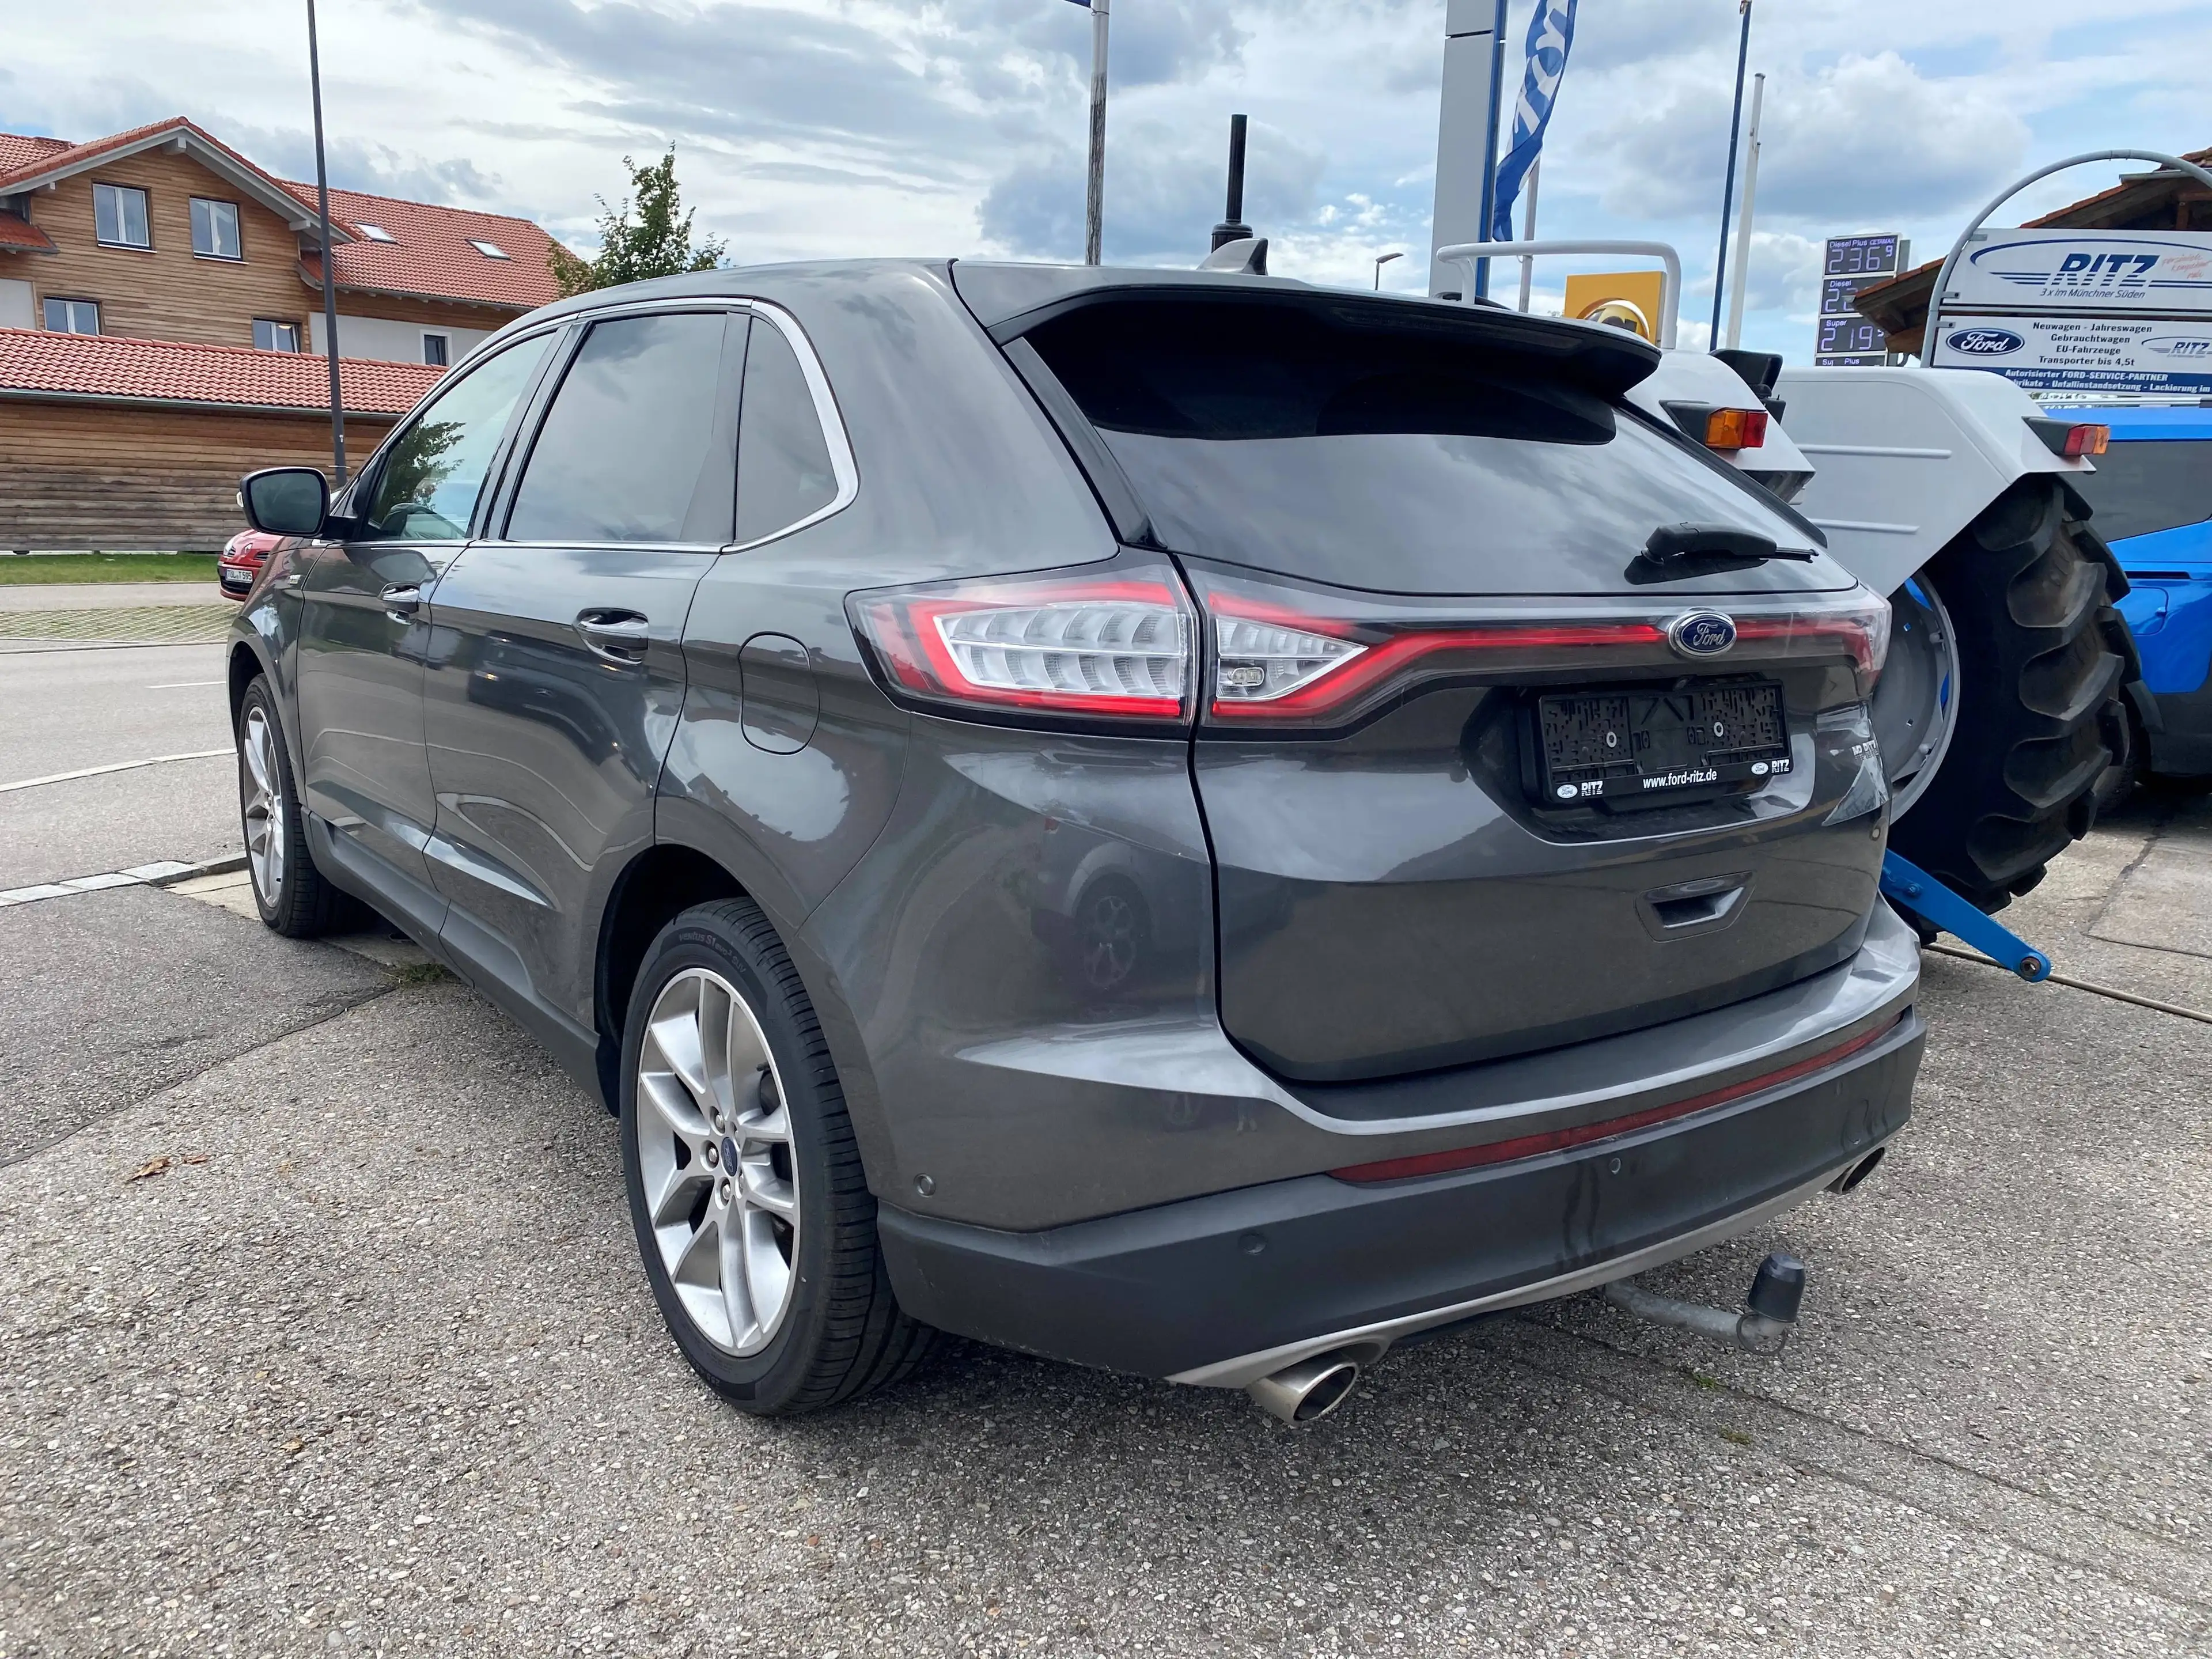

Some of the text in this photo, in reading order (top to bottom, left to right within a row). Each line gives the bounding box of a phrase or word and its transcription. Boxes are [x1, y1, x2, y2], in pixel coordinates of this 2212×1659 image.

[2051, 253, 2160, 287] RITZ
[2040, 289, 2046, 297] 3
[2055, 289, 2067, 297] im
[2068, 289, 2115, 298] Münchner
[2115, 290, 2146, 298] Süden
[1826, 320, 1847, 328] Super
[2033, 322, 2081, 331] Neuwagen
[2090, 324, 2152, 334] Jahreswagen
[1961, 332, 2010, 351] Ford
[2051, 334, 2130, 344] Gebrauchtwagen
[2056, 345, 2121, 355] EU-Fahrzeuge
[2171, 342, 2210, 354] RITZ
[2039, 356, 2095, 366] Transporter
[2115, 358, 2135, 366] 4,5t
[2005, 369, 2168, 381] Autorisierter FORD-SERVICE-PARTNER
[2052, 380, 2142, 391] Unfallinstandsetzung
[2149, 383, 2198, 393] Lackierung
[242, 571, 252, 580] 595
[1693, 623, 1726, 646] Ford
[1581, 781, 1603, 797] RITZ
[1643, 768, 1717, 789] www.ford-ritz.de
[1771, 759, 1789, 773] RITZ
